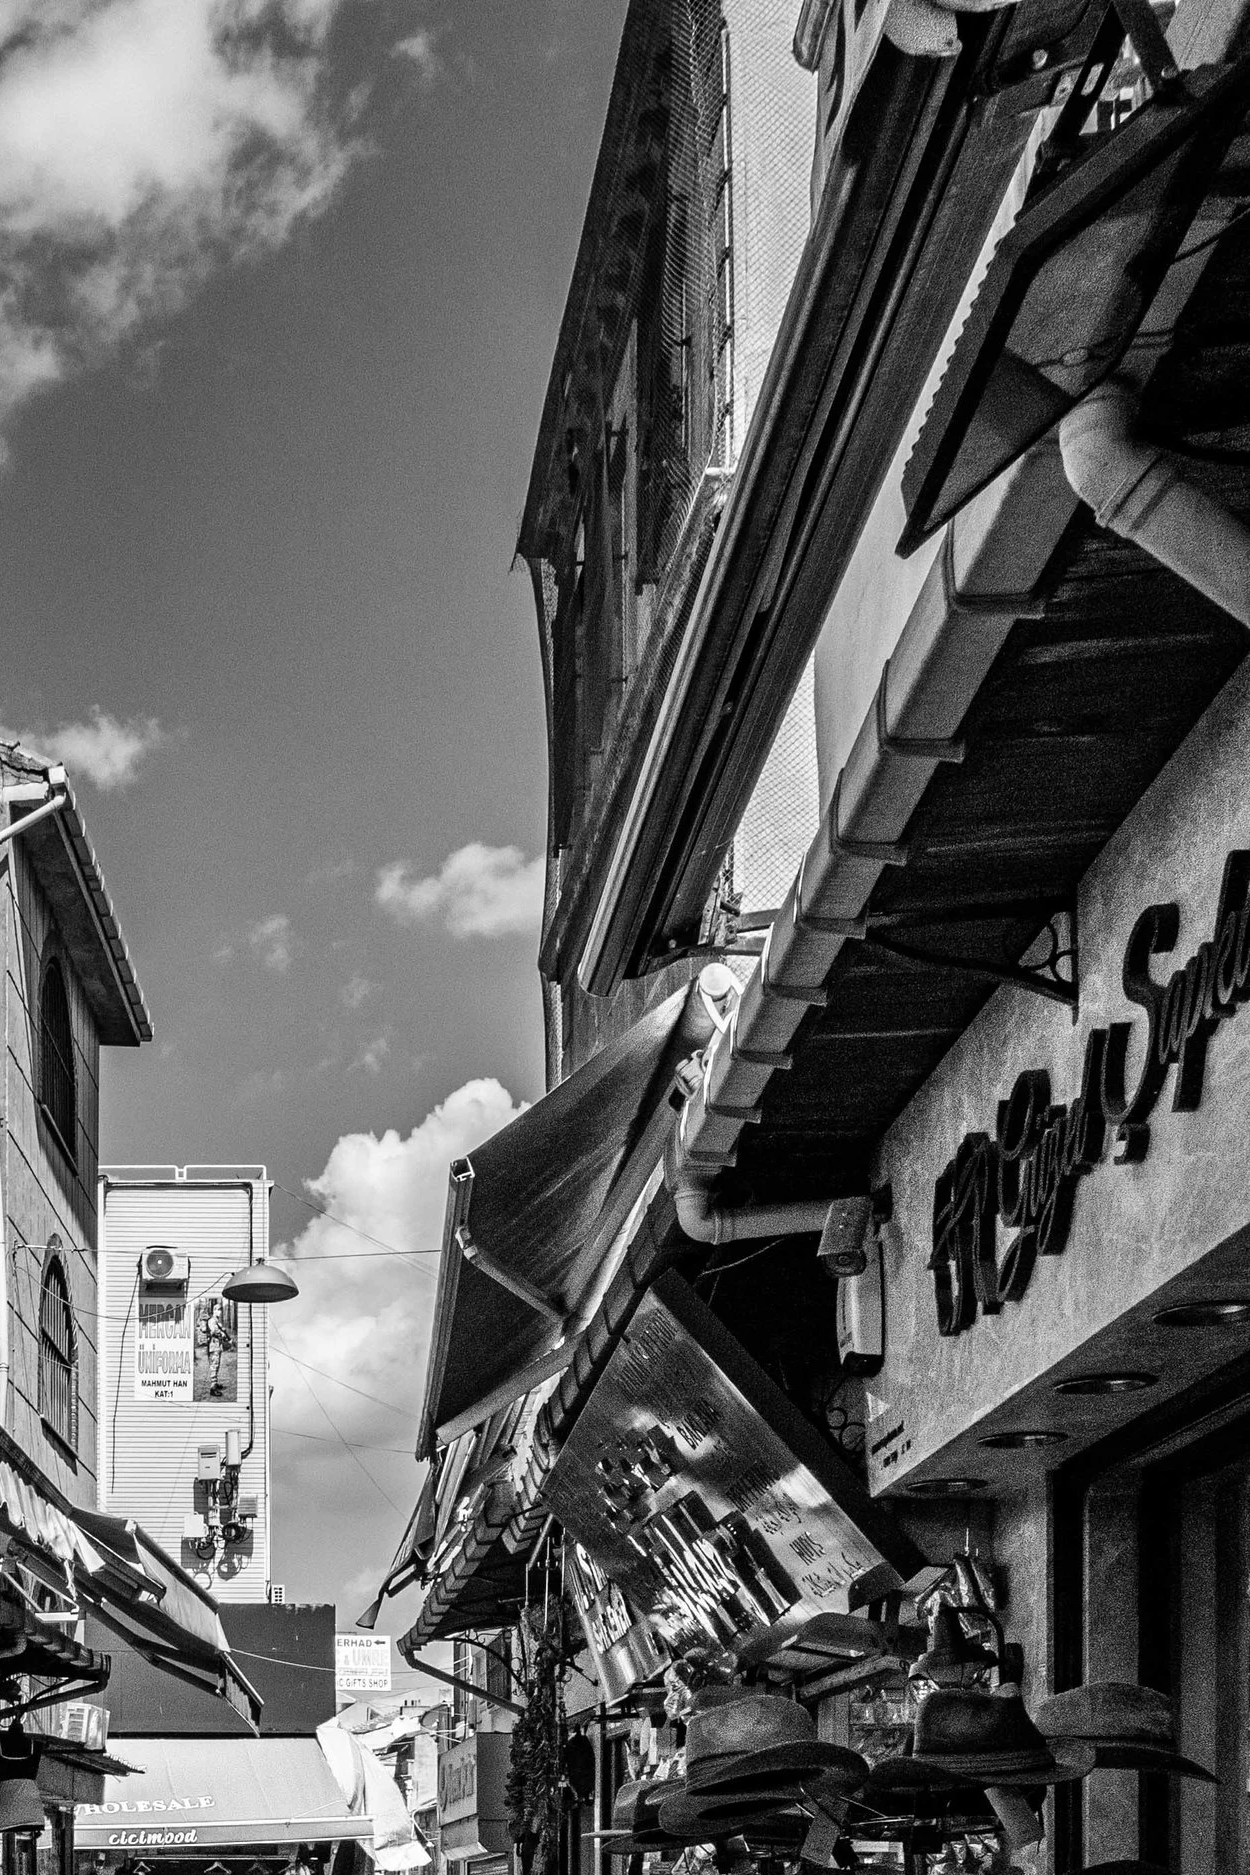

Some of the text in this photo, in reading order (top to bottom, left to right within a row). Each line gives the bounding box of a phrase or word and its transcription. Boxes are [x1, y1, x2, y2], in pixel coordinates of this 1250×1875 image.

[138, 1303, 191, 1339] MERCAN
[138, 1344, 191, 1375] ÜNİFORMA
[141, 1380, 188, 1388] MAHMUT HAN
[675, 1397, 721, 1450] BAKLAVA
[790, 1532, 826, 1567] NUTS
[345, 1678, 367, 1688] GIFTS
[368, 1678, 388, 1689] SHOP
